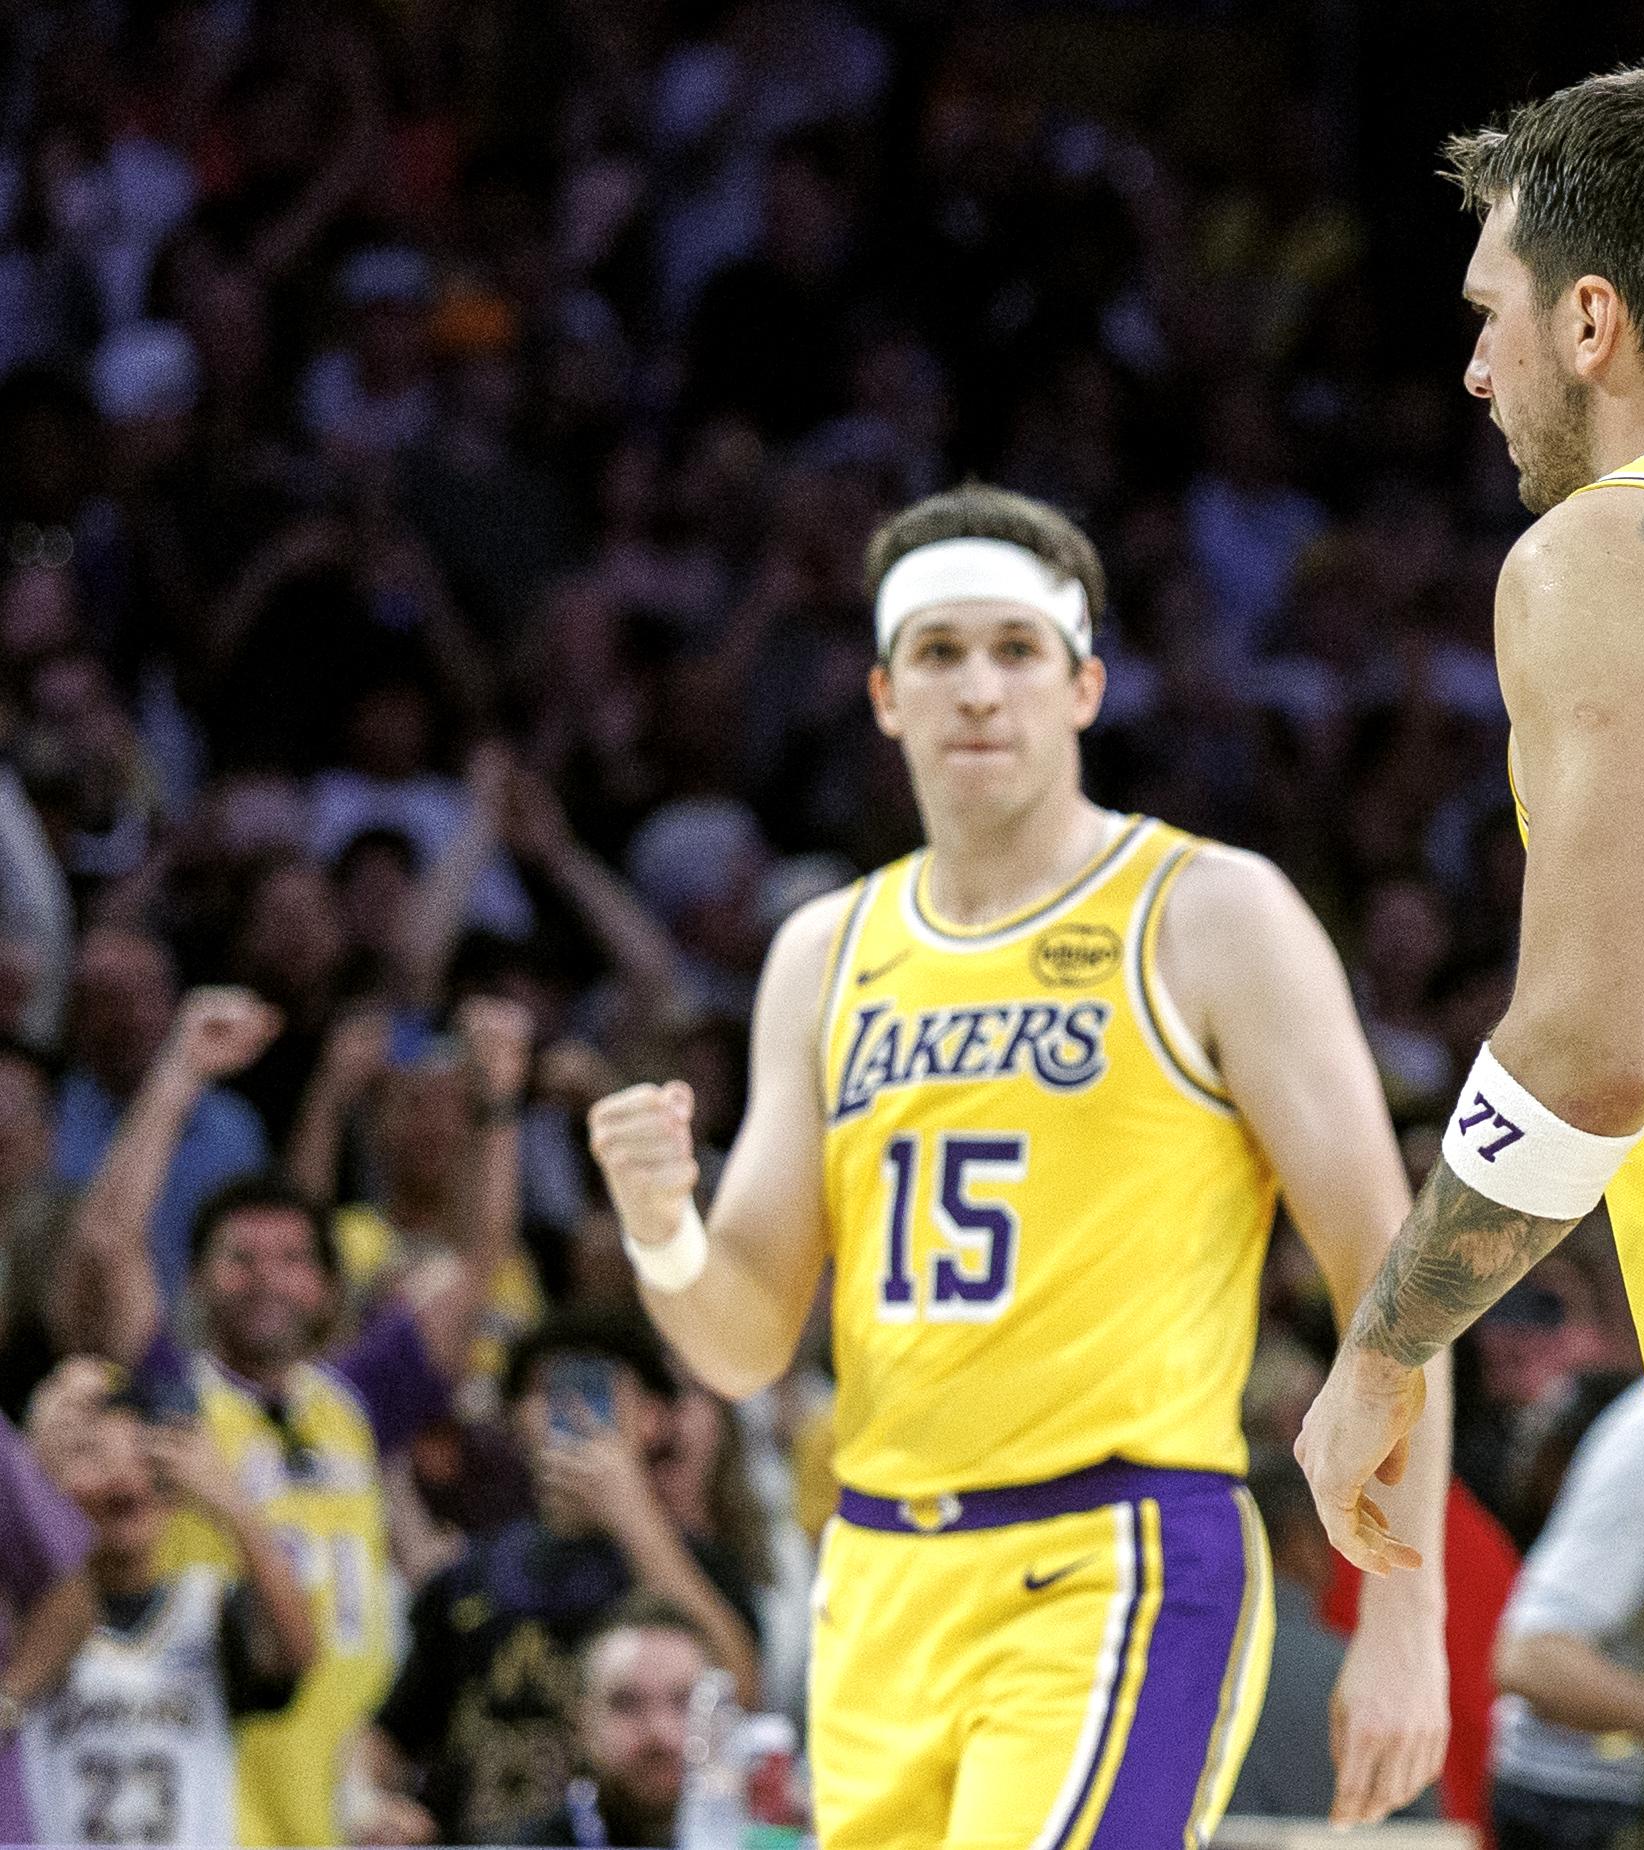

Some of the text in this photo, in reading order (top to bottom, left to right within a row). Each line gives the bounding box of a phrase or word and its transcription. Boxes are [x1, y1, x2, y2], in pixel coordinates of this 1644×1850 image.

[831, 1000, 1113, 1122] LAKERS
[1458, 1091, 1525, 1164] 77
[880, 1134, 1027, 1320] 15
